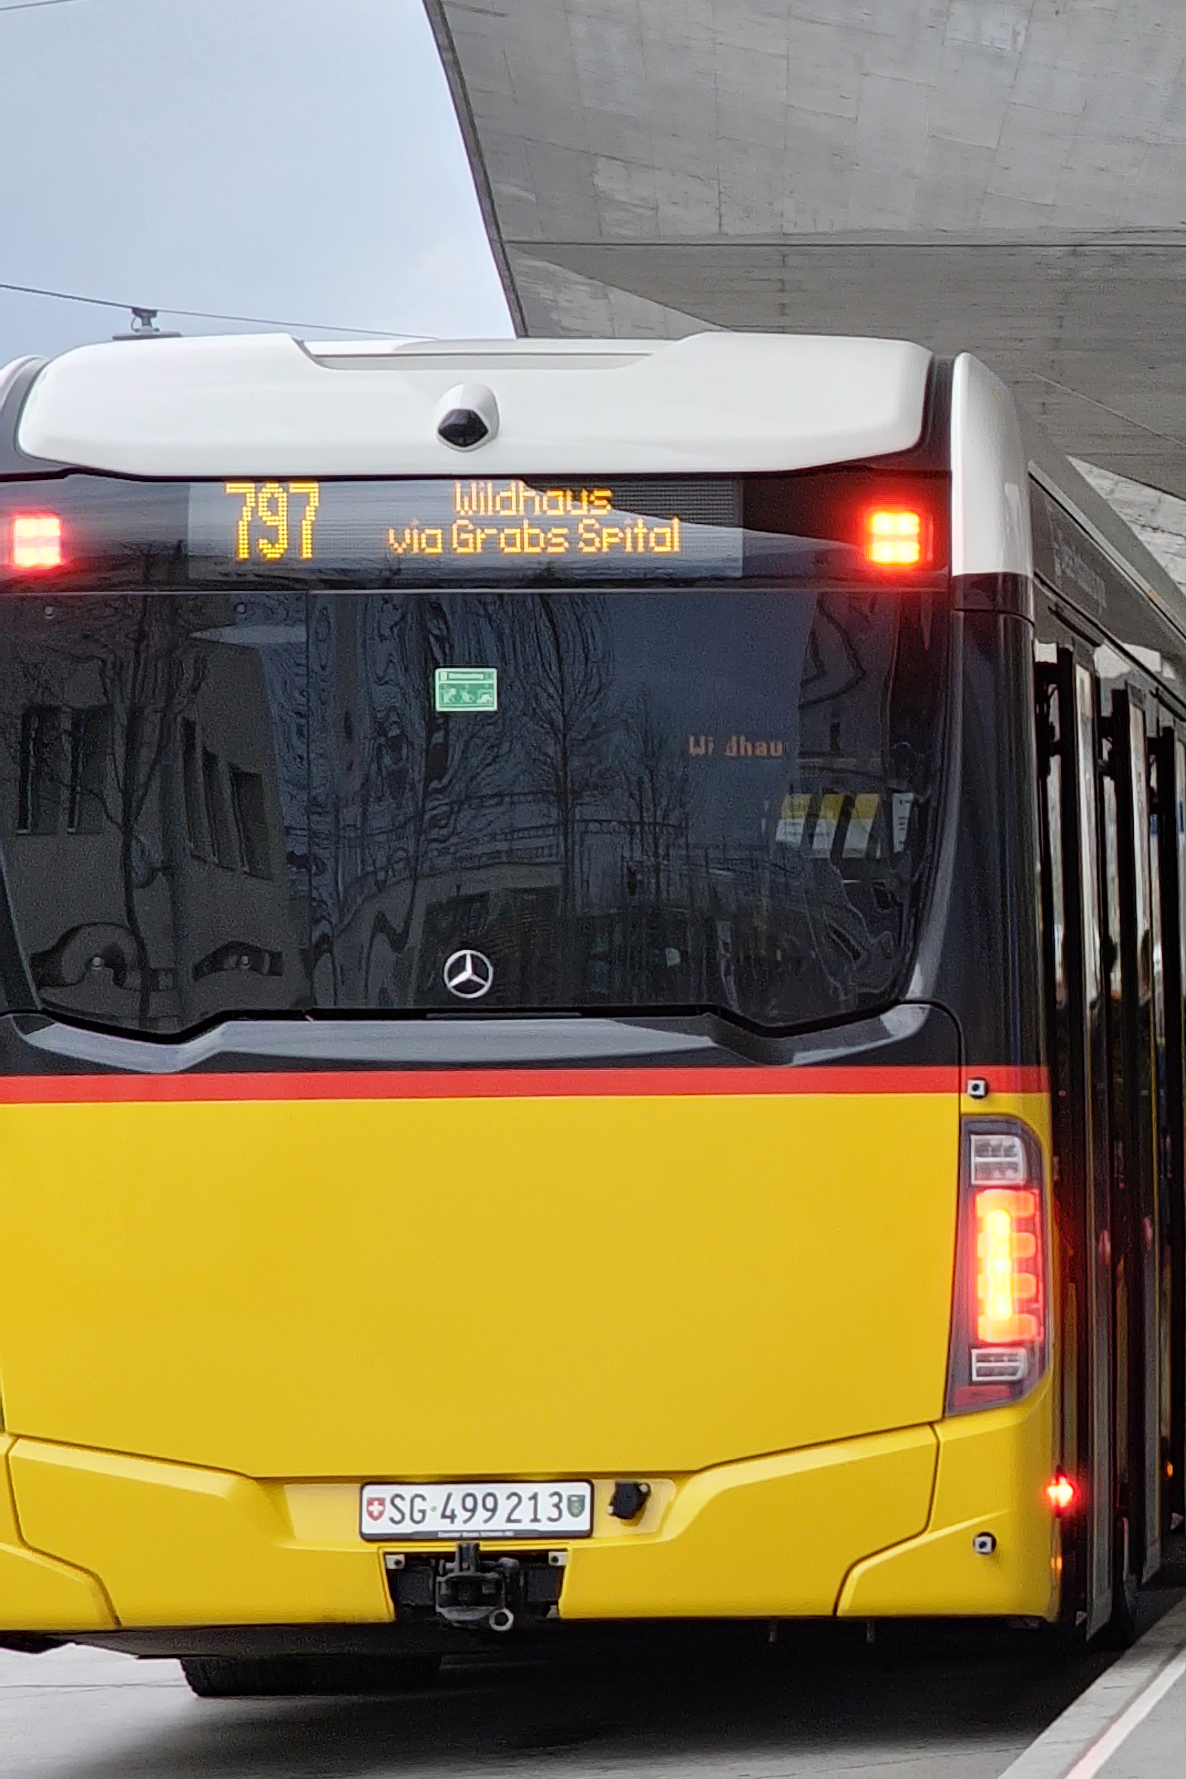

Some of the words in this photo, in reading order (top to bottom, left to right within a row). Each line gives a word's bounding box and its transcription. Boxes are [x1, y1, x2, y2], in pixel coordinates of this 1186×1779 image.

[225, 482, 320, 560] 797
[454, 480, 613, 516] Wildhaus
[387, 516, 444, 554] via
[450, 518, 570, 554] Grabs
[576, 516, 682, 554] Spital
[389, 1493, 427, 1525] SG
